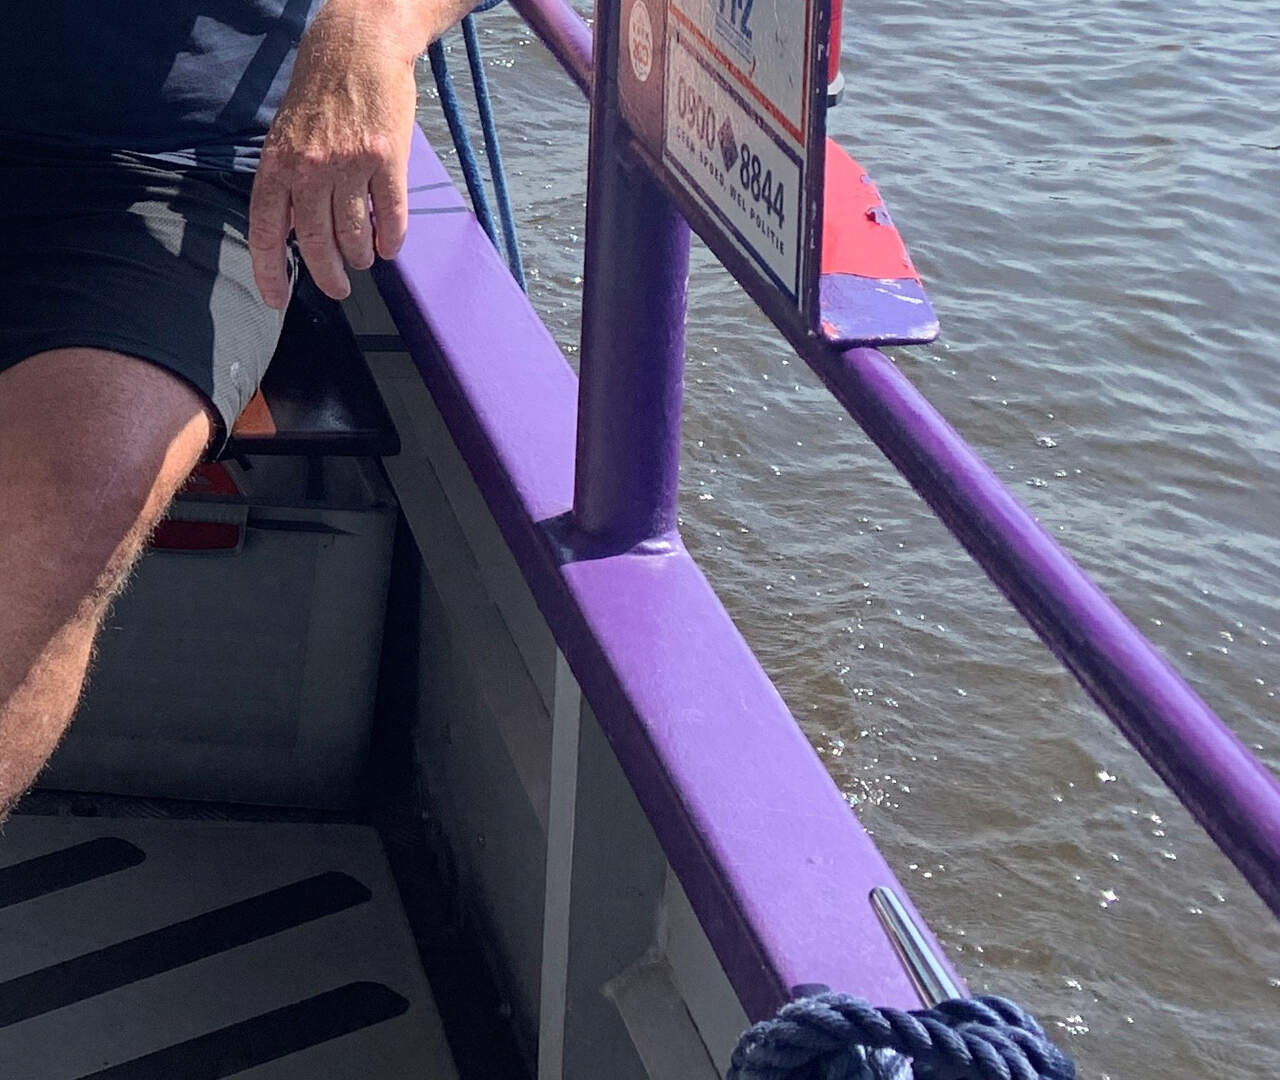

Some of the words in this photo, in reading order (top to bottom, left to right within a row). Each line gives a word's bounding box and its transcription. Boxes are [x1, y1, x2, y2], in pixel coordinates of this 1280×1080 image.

[677, 75, 716, 151] 0900
[739, 143, 785, 230] 8844
[729, 183, 747, 213] WEL
[749, 208, 785, 257] POLITIE
